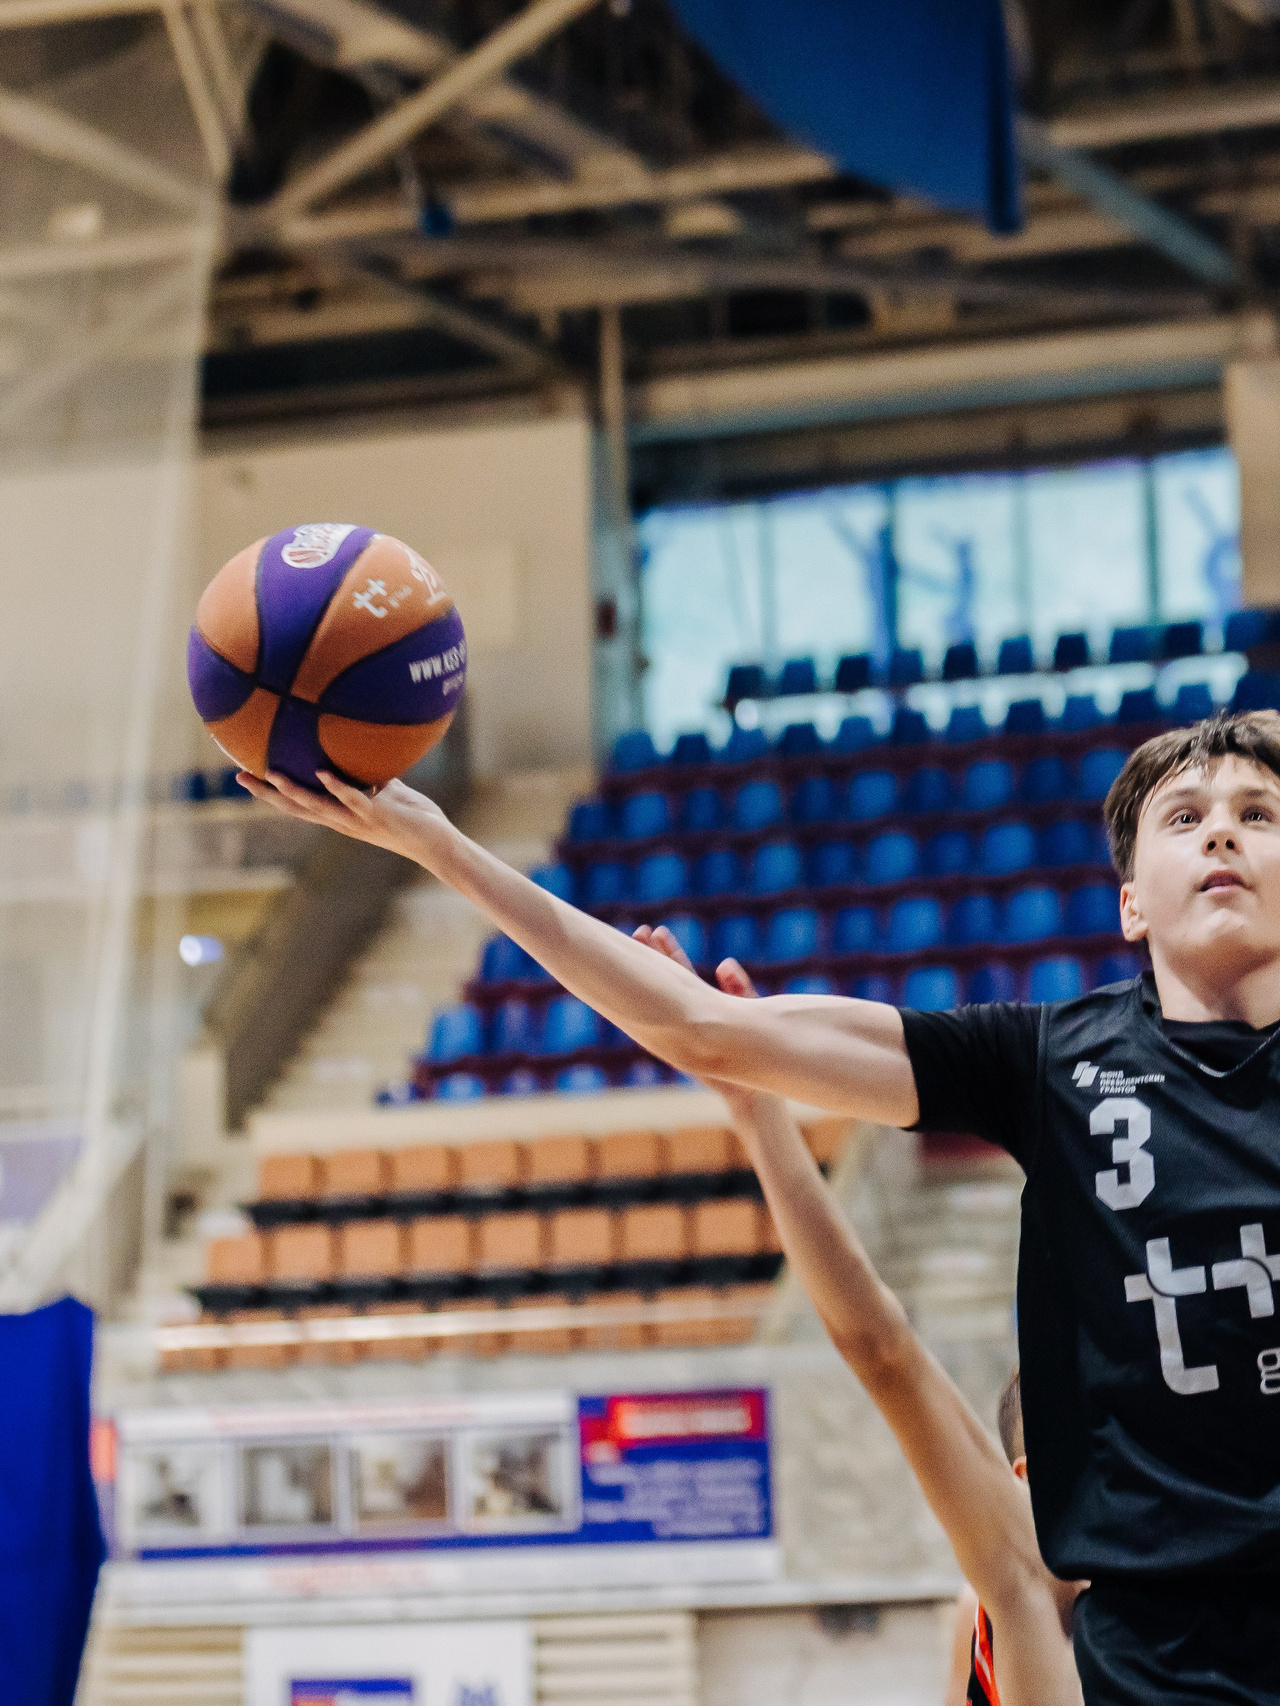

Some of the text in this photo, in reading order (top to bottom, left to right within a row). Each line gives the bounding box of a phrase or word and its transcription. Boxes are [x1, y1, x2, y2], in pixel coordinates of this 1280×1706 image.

[1099, 1070, 1124, 1079] ФОНД
[1100, 1085, 1136, 1094] ГРАНТОВ
[1089, 1097, 1156, 1211] 3
